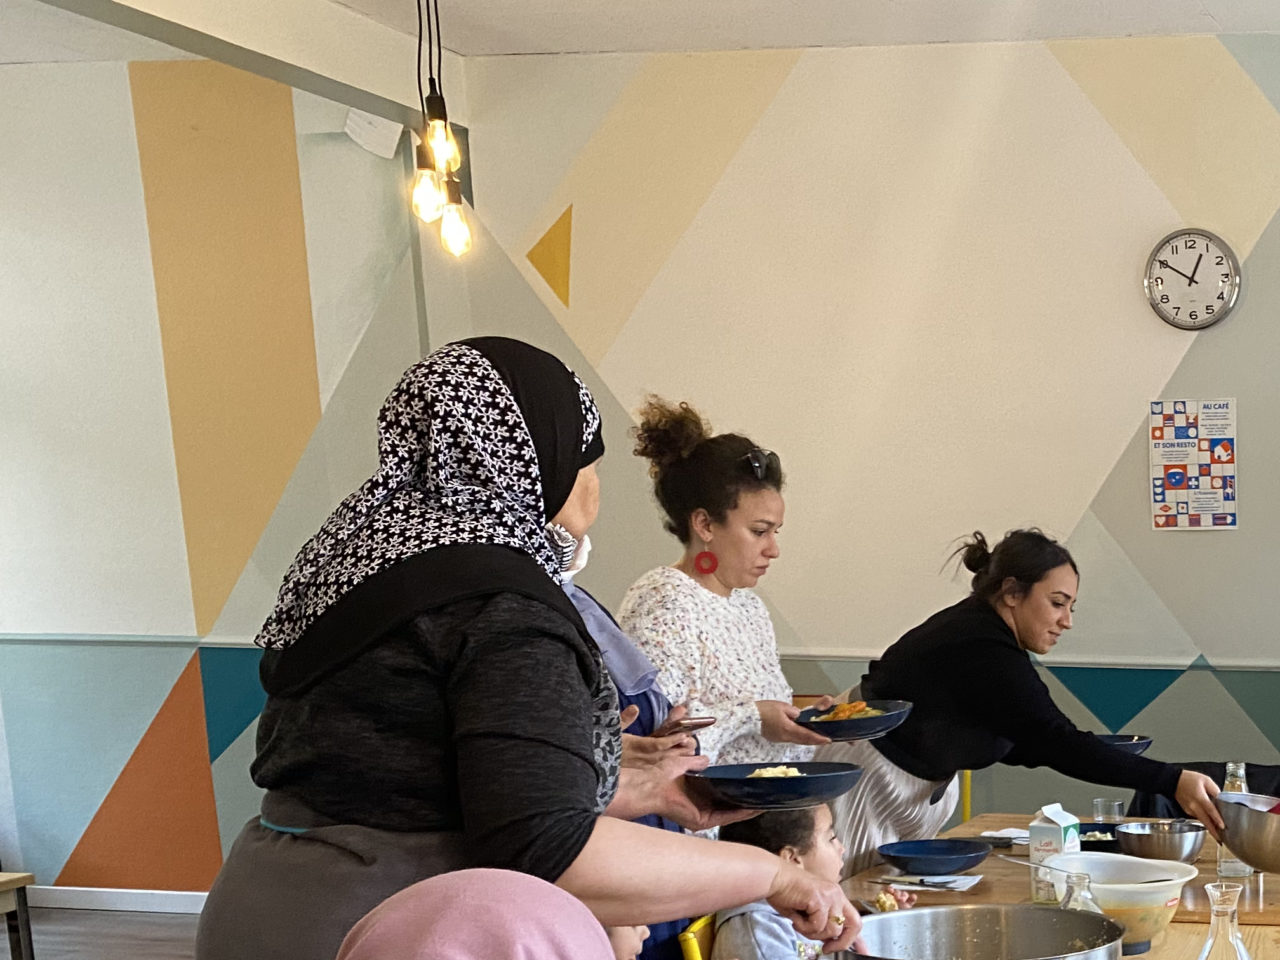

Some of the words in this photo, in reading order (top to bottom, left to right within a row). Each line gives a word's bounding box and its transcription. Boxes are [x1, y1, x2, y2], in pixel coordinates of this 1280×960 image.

[1171, 244, 1178, 255] 11
[1184, 239, 1197, 250] 12
[1159, 259, 1169, 269] 10
[1215, 255, 1224, 266] 2
[1154, 276, 1164, 287] 9
[1221, 273, 1230, 283] 3
[1160, 294, 1170, 304] 8
[1216, 291, 1225, 301] 4
[1172, 306, 1181, 317] 7
[1205, 304, 1215, 315] 5
[1189, 310, 1198, 320] 6
[1213, 402, 1230, 410] CAFÉ
